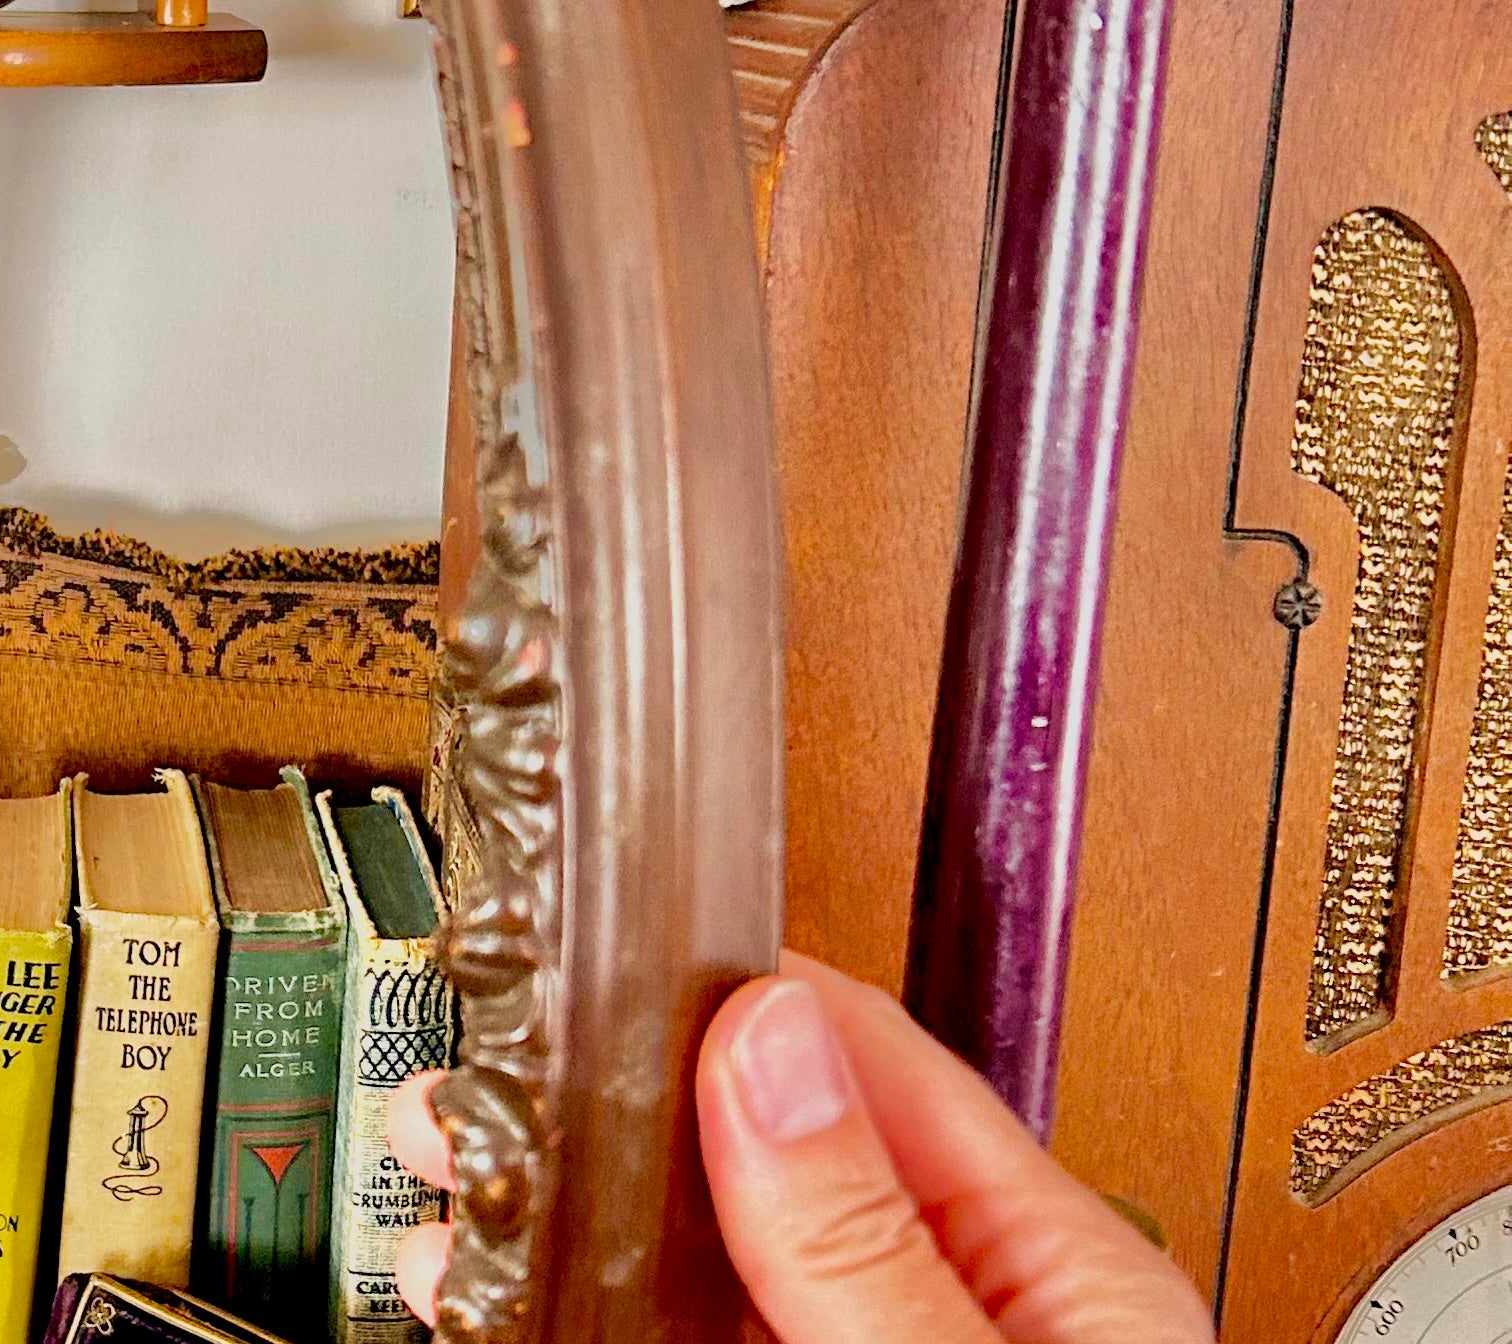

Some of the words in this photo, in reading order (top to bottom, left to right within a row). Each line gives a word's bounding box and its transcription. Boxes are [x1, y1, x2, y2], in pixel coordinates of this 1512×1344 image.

[123, 939, 182, 967] TOM
[7, 960, 61, 990] LEE
[128, 975, 172, 1002] THE
[94, 1007, 198, 1036] TELEPHONE
[234, 999, 324, 1021] FROM
[231, 1026, 320, 1048] HOME
[120, 1044, 172, 1071] BOY
[239, 1060, 316, 1078] ALGER
[380, 1156, 405, 1171] CL
[371, 1175, 392, 1189] IN
[375, 1212, 421, 1228] WALL
[1444, 1234, 1480, 1267] 700
[356, 1281, 401, 1295] CAR
[1374, 1300, 1404, 1337] 600
